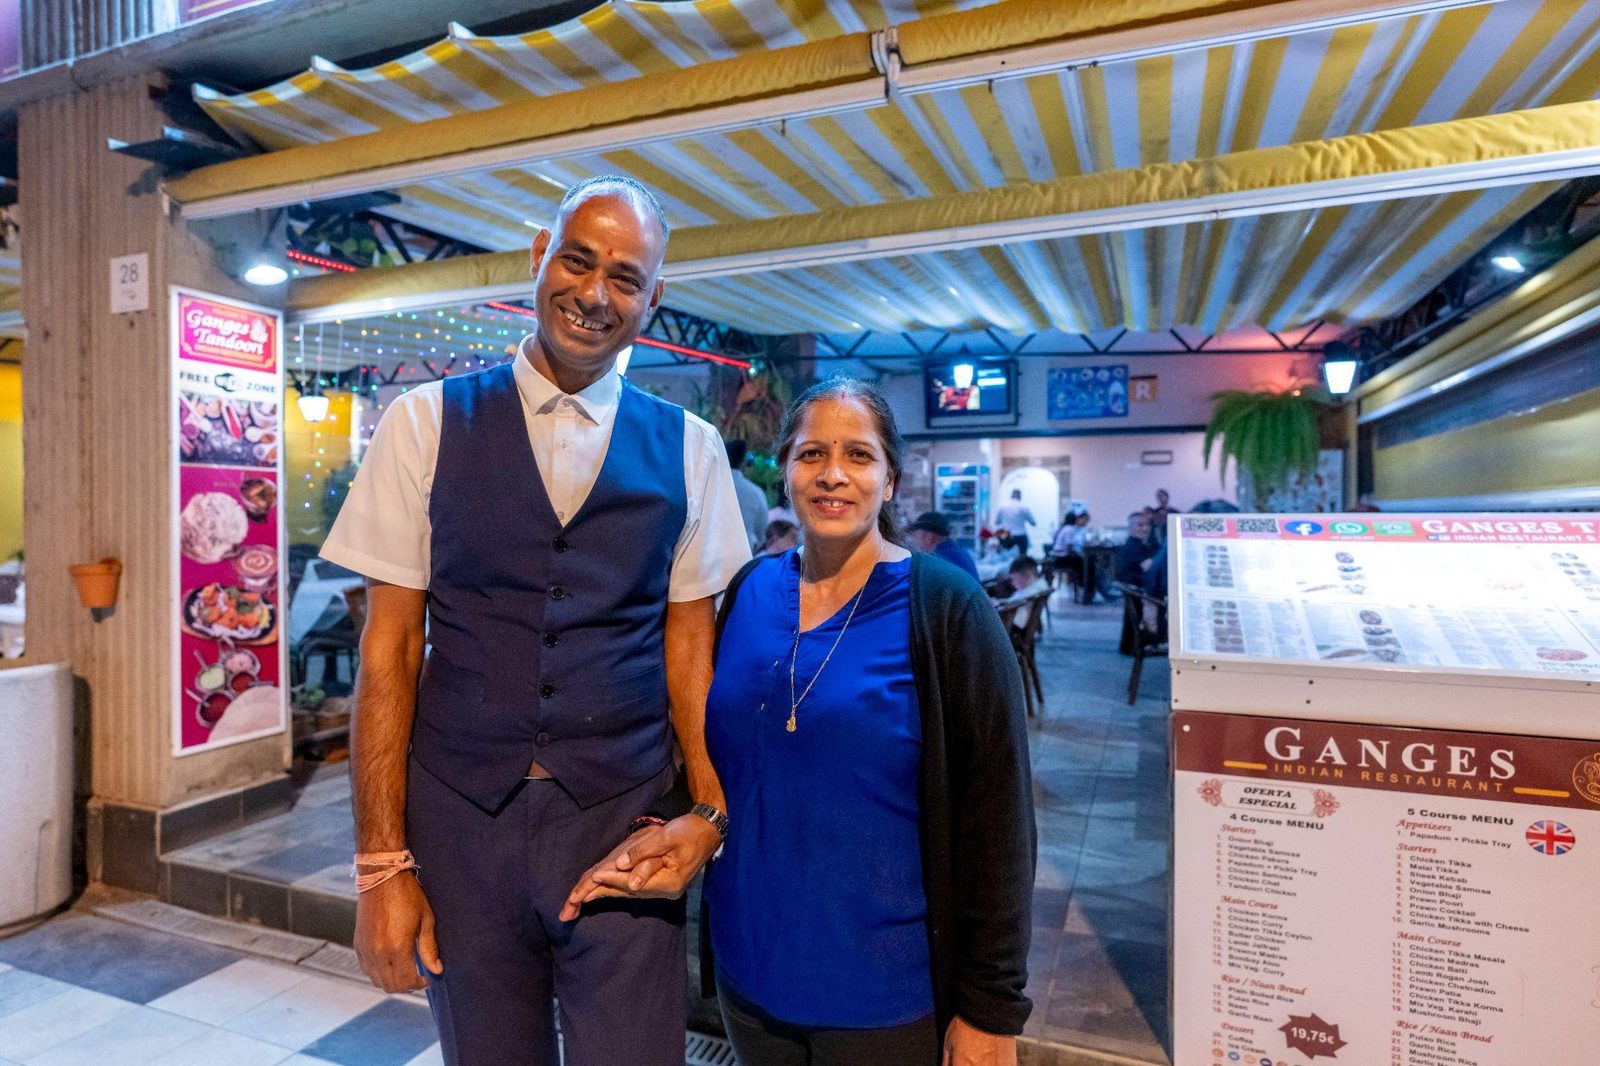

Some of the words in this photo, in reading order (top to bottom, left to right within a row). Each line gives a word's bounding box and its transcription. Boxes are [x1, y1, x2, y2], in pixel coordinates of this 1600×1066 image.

[120, 263, 139, 284] 28
[186, 309, 250, 336] Ganges
[193, 328, 264, 355] Tandoori
[180, 372, 209, 383] FREE
[246, 382, 275, 393] ZONE
[1422, 520, 1563, 534] GANGES
[1500, 534, 1581, 542] RESTAURANT
[1264, 726, 1516, 780] GANGES
[1274, 763, 1344, 779] INDIAN
[1361, 771, 1504, 793] RESTAURANT
[1244, 787, 1291, 798] OFERTA
[1238, 797, 1297, 810] ESPECIAL
[1241, 814, 1282, 825] Course
[1287, 820, 1324, 830] MENU
[1396, 819, 1452, 831] Appetizers
[1420, 810, 1466, 820] Course
[1472, 814, 1514, 825] MENU
[1220, 824, 1256, 834] Starters
[1410, 831, 1451, 841] Papadum
[1492, 841, 1511, 849] Tray
[1396, 843, 1437, 853] Starters
[1410, 856, 1446, 865] Chicken
[1449, 860, 1472, 868] Tikka
[1410, 880, 1453, 890] Vegetable
[1456, 885, 1491, 895] Samosa
[1410, 887, 1436, 896] Onion
[1439, 891, 1461, 900] Bhaji
[1220, 896, 1245, 905] Main
[1248, 900, 1279, 910] Course
[1410, 895, 1437, 904] Prawn
[1410, 903, 1437, 912] Prawn
[1440, 907, 1476, 917] Cocktail
[1409, 919, 1435, 928] Garlic
[1438, 923, 1490, 935] Mushrooms
[1410, 911, 1445, 921] Chicken
[1448, 915, 1471, 923] Tikka
[1474, 919, 1492, 928] with
[1496, 922, 1529, 933] Cheese
[1397, 931, 1424, 940] Main
[1428, 936, 1462, 947] Course
[1409, 945, 1445, 955] Chicken
[1448, 950, 1471, 958] Tikka
[1474, 954, 1505, 964] Masala
[1409, 952, 1445, 962] Chicken
[1447, 958, 1479, 968] Madras
[1409, 960, 1445, 970] Chicken
[1409, 968, 1433, 977] Lamb
[1436, 972, 1464, 982] Rogan
[1468, 977, 1489, 985] Josh
[1409, 976, 1445, 986] Chicken
[1221, 974, 1240, 983] Rice
[1250, 979, 1276, 990] Naan
[1278, 984, 1308, 995] Bread
[1409, 984, 1436, 993] Prawn
[1409, 992, 1445, 1002] Chicken
[1448, 998, 1471, 1006] Tikka
[1473, 1002, 1504, 1013] Korma
[1409, 1008, 1456, 1020] Mushroom
[1458, 1016, 1481, 1026] Bhaji
[1221, 1022, 1254, 1034] Dessert
[1291, 1026, 1335, 1044] 19,75€
[1396, 1020, 1418, 1030] Rice
[1428, 1026, 1458, 1036] Naan
[1460, 1030, 1494, 1043] Bread
[1409, 1041, 1435, 1050] Garlic
[1437, 1046, 1456, 1054] Rice
[1436, 1038, 1456, 1046] Rice
[1409, 1049, 1456, 1062] Mushroom
[1458, 1058, 1478, 1066] Rice
